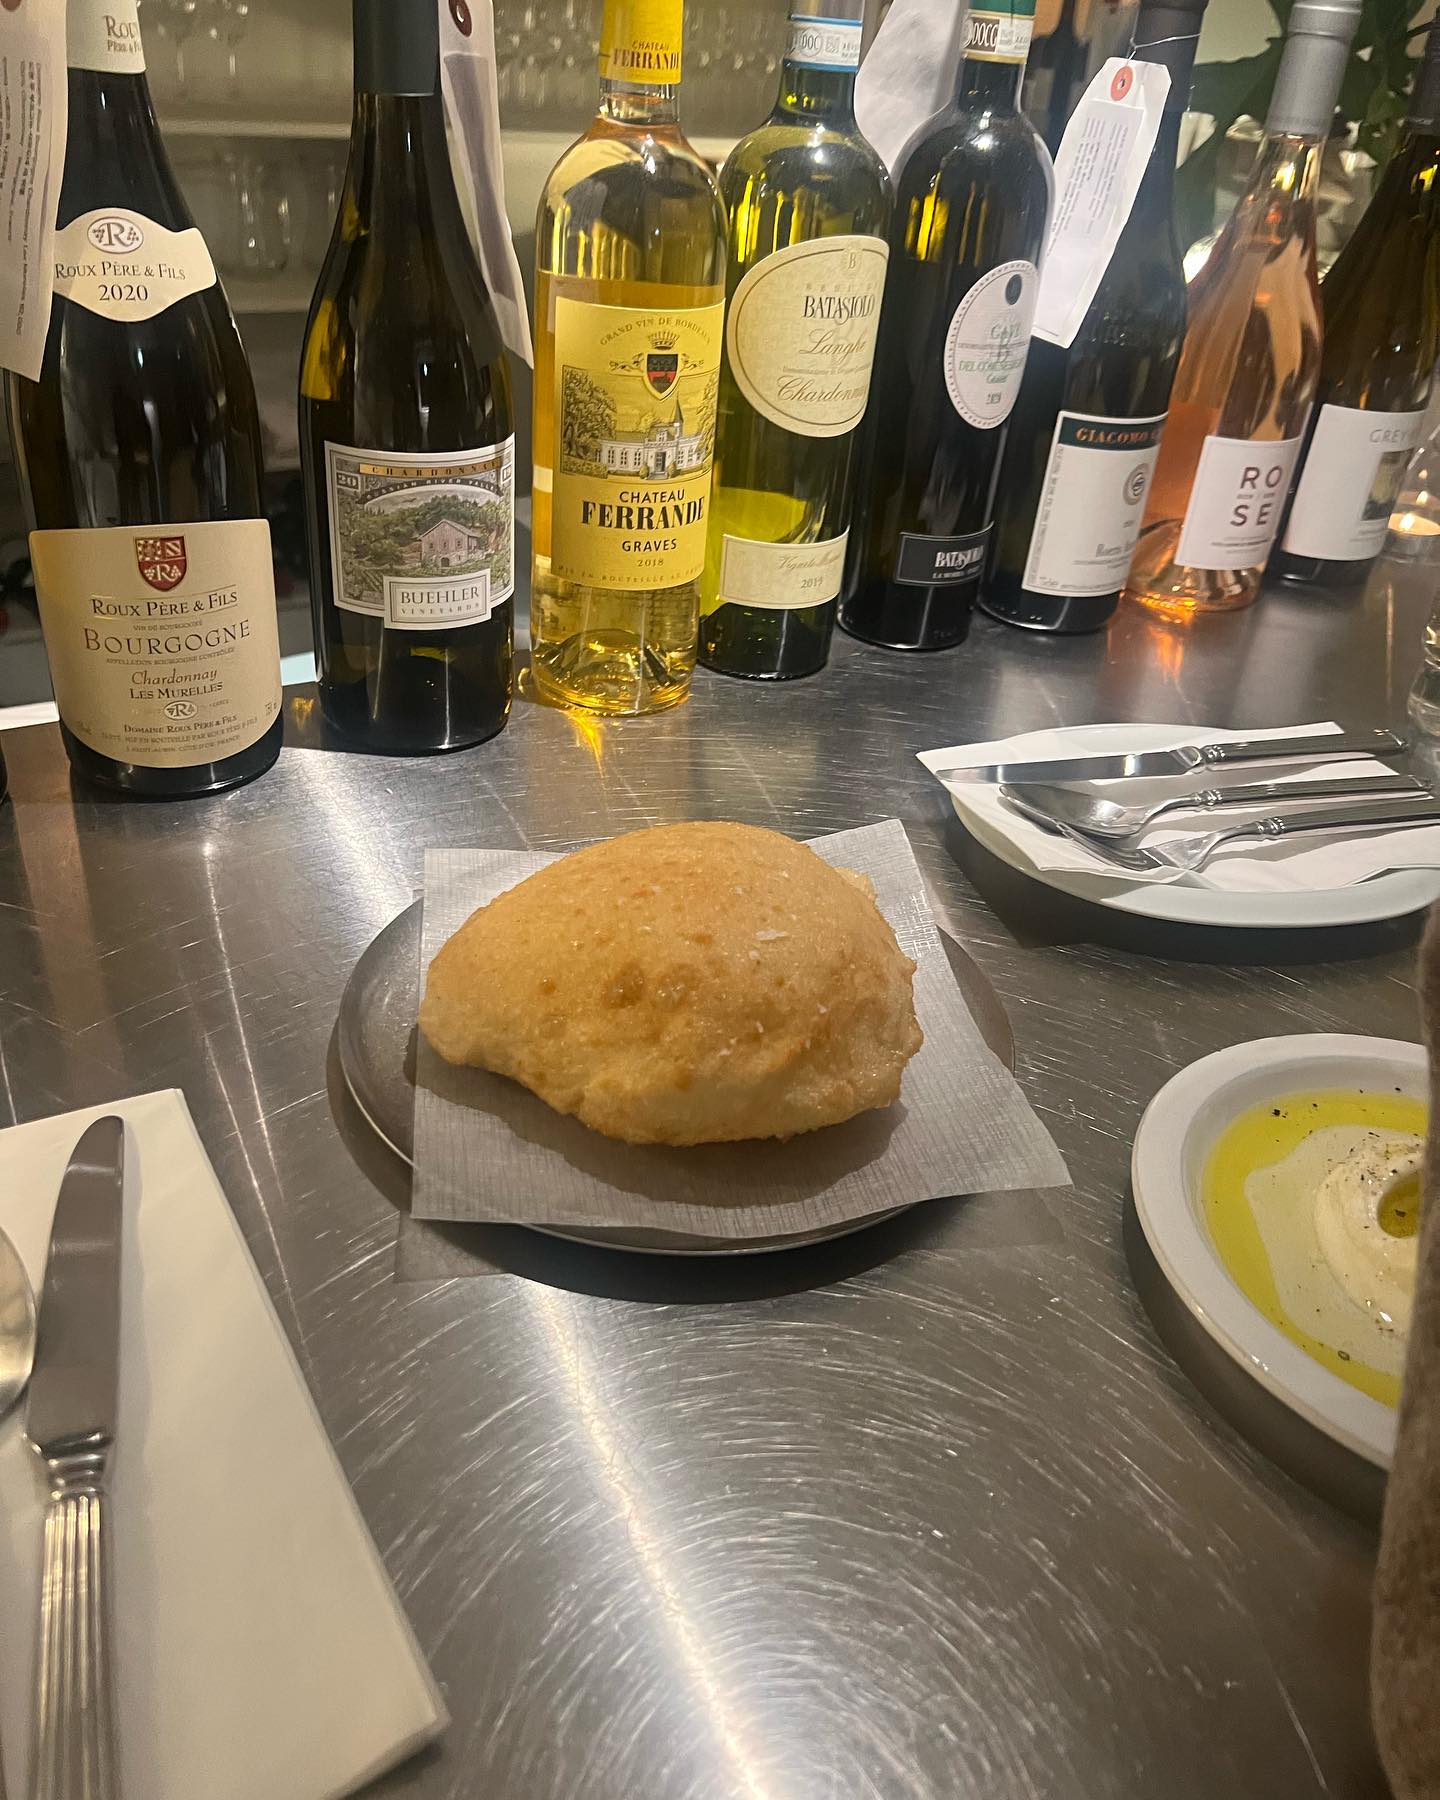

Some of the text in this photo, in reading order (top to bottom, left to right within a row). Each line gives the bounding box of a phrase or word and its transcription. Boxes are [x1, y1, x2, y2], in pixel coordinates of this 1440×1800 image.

[55, 261, 186, 280] ROUX PÈRE & FILS
[98, 285, 148, 301] 2020
[658, 317, 671, 326] DE
[1075, 427, 1149, 444] GIACOMO
[1240, 465, 1282, 489] RO
[619, 488, 685, 503] CHATEAU
[581, 496, 704, 530] FERRANDE
[1230, 502, 1273, 527] SE
[622, 538, 677, 552] GRAVES
[637, 559, 664, 567] 2018
[92, 591, 238, 616] ROUX PÈRE & FILS
[401, 587, 479, 604] BUEHLER
[401, 603, 480, 615] VINEYARDS
[83, 619, 250, 655] BOURGOGNE
[131, 667, 218, 686] Chardonnay
[129, 681, 224, 699] LES MURELLES
[124, 724, 164, 734] DOMAINE
[166, 724, 191, 734] ROUX
